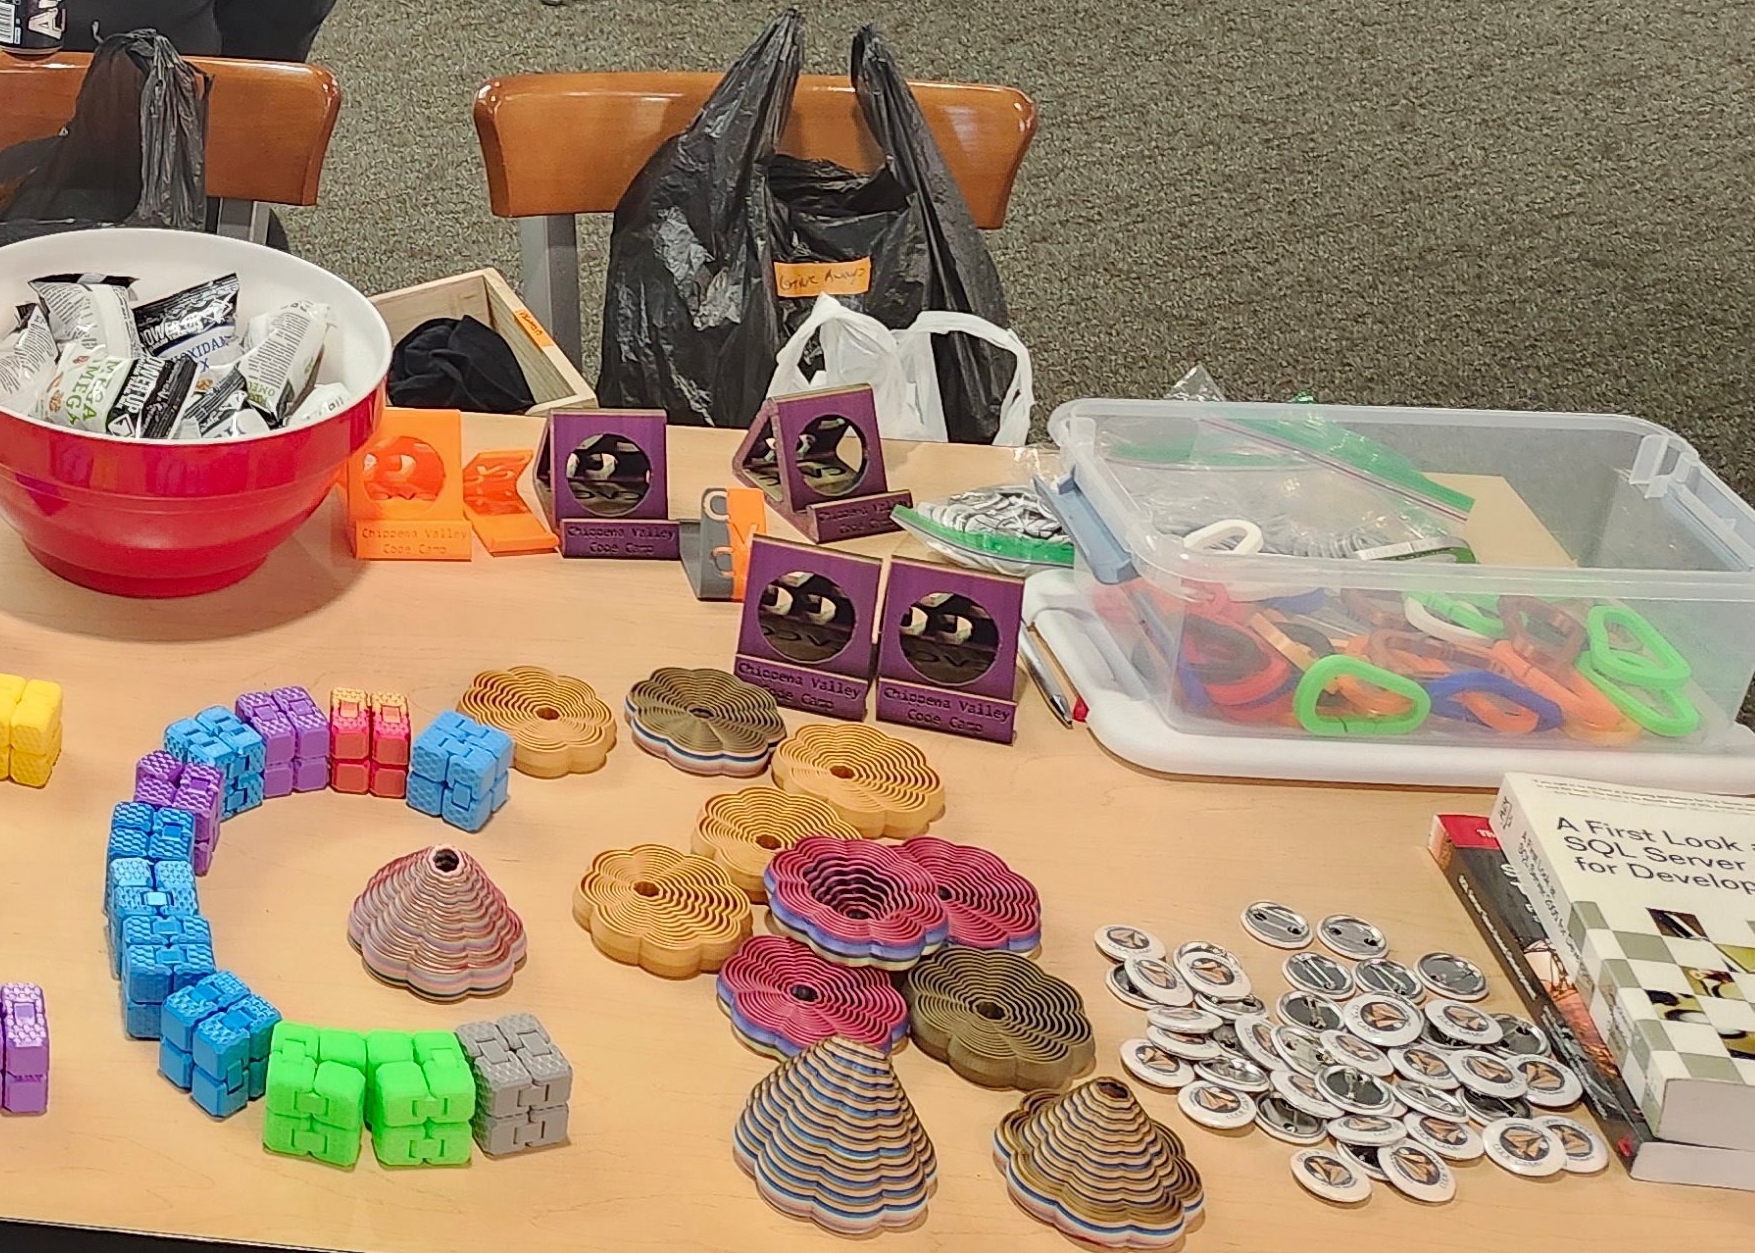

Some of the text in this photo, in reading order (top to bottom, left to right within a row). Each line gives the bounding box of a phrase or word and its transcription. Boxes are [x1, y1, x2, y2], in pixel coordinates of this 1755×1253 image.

[810, 674, 863, 700] Valley
[959, 700, 1011, 723] Valley
[1557, 817, 1744, 853] A First Look
[1564, 836, 1746, 871] SQL Server
[1574, 856, 1618, 875] for
